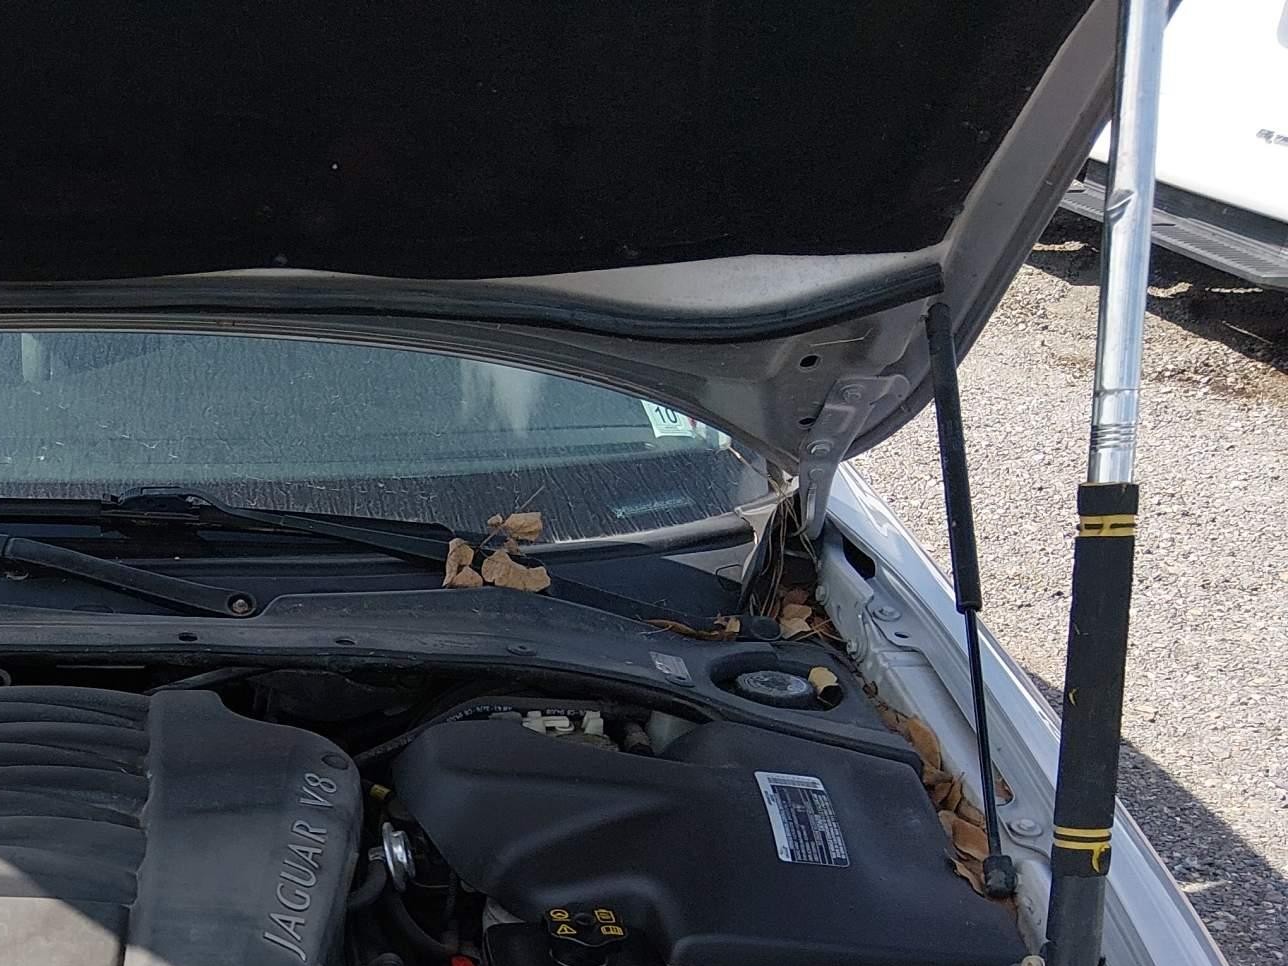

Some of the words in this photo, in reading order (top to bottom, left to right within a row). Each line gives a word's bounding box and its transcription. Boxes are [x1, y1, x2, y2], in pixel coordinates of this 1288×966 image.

[655, 406, 678, 423] 10
[263, 819, 328, 962] JAGUAR
[299, 773, 337, 808] V8
